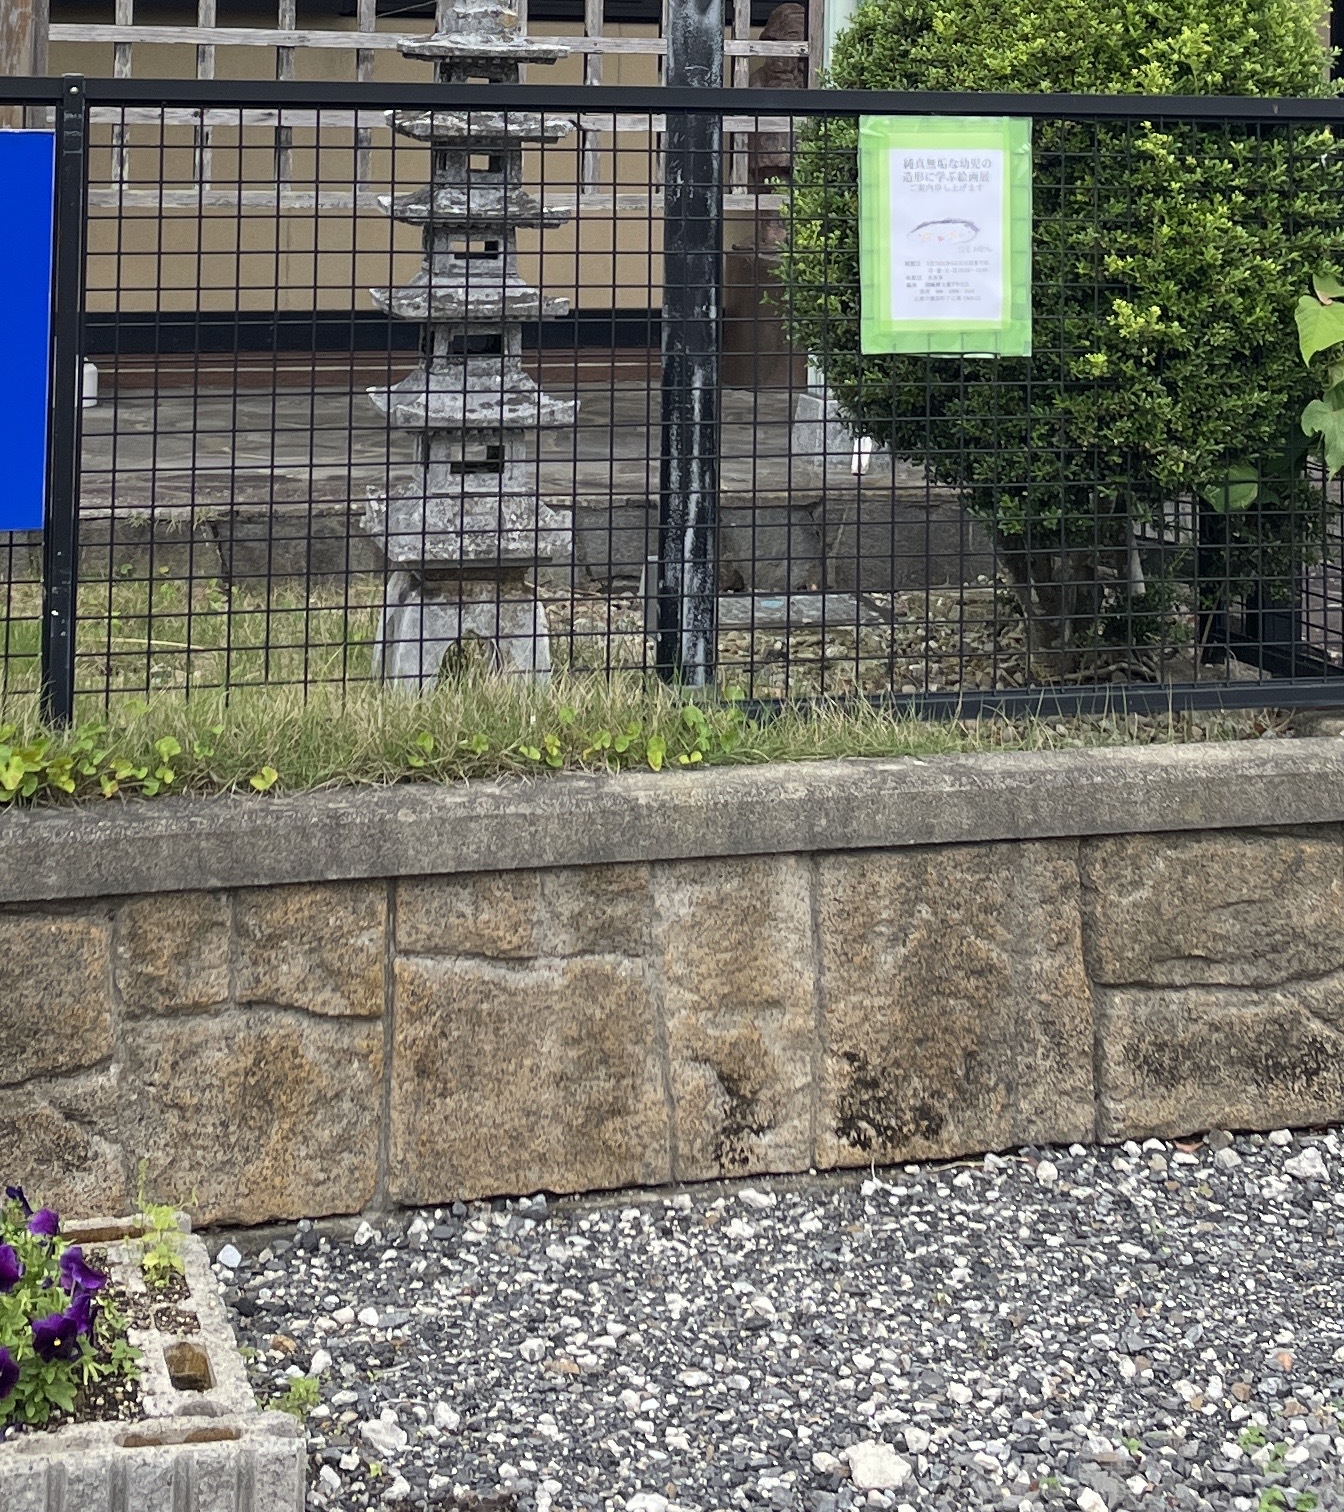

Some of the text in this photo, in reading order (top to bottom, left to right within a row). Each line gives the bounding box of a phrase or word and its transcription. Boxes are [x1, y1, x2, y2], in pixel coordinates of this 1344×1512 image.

[902, 170, 991, 183] 造形に学ぶ絵画展
